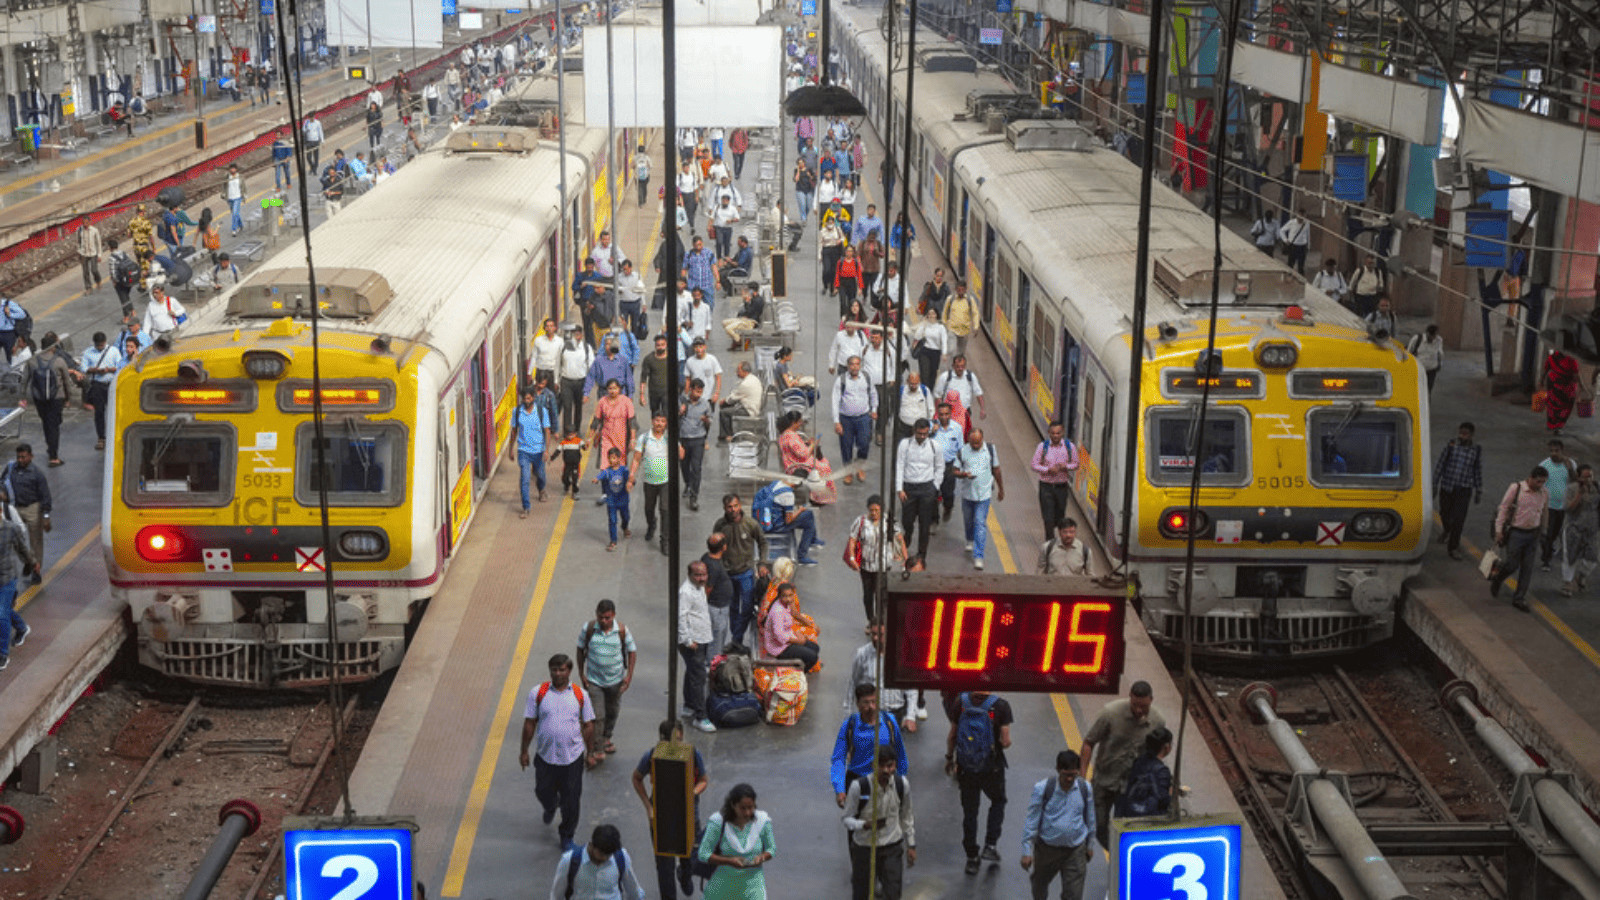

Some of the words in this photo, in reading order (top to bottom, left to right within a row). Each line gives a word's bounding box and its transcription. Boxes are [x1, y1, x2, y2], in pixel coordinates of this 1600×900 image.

[243, 474, 281, 488] 5033
[1257, 476, 1305, 490] 5005
[234, 496, 292, 525] ICF
[926, 598, 1112, 673] 10:15
[320, 854, 379, 900] 2
[1152, 851, 1208, 900] 3
